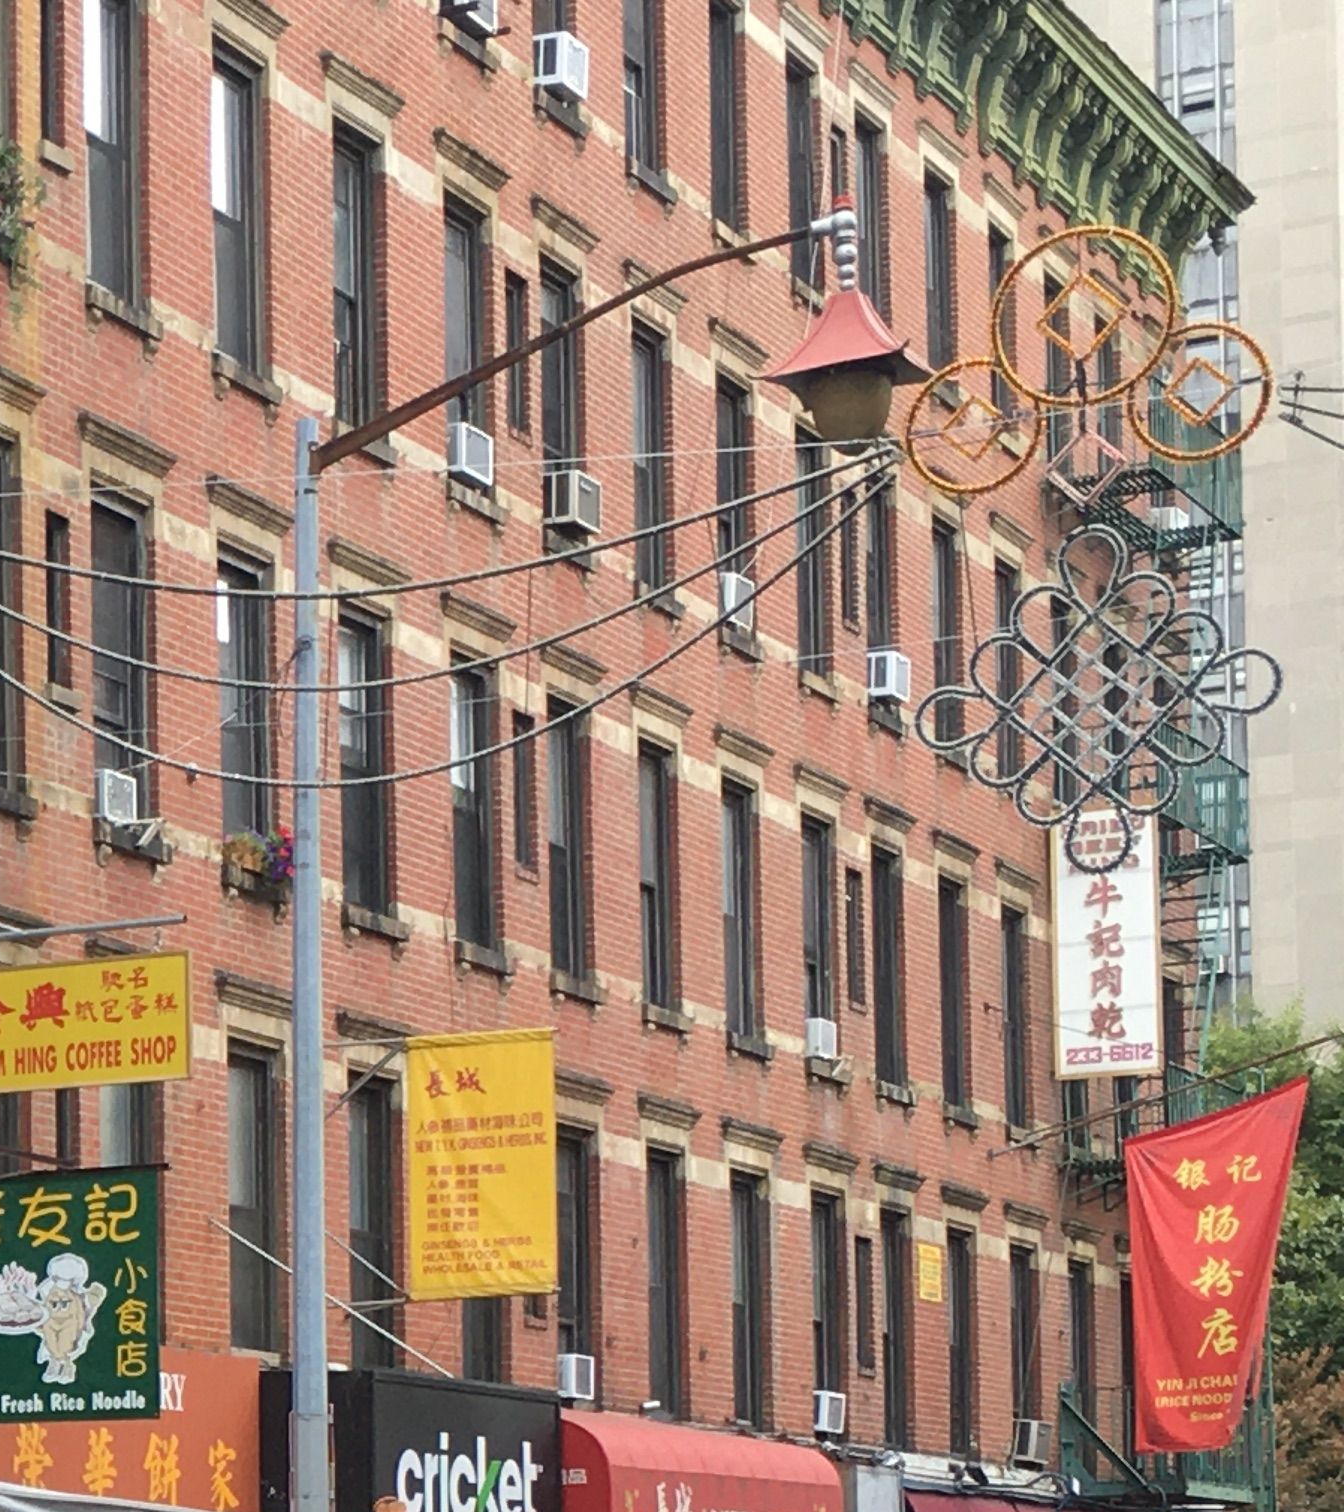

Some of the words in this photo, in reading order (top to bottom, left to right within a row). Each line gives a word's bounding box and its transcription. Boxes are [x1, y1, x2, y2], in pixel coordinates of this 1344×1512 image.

[14, 1045, 58, 1076] HING
[66, 1039, 123, 1072] COFFEE
[130, 1034, 178, 1066] SHOP
[1066, 1043, 1153, 1065] 233-6612
[114, 1257, 149, 1379] 小食店
[1155, 1378, 1184, 1392] YIN
[1185, 1377, 1199, 1390] JI
[0, 1393, 44, 1414] Fresh
[50, 1392, 85, 1412] Rice
[92, 1389, 146, 1411] Noodle
